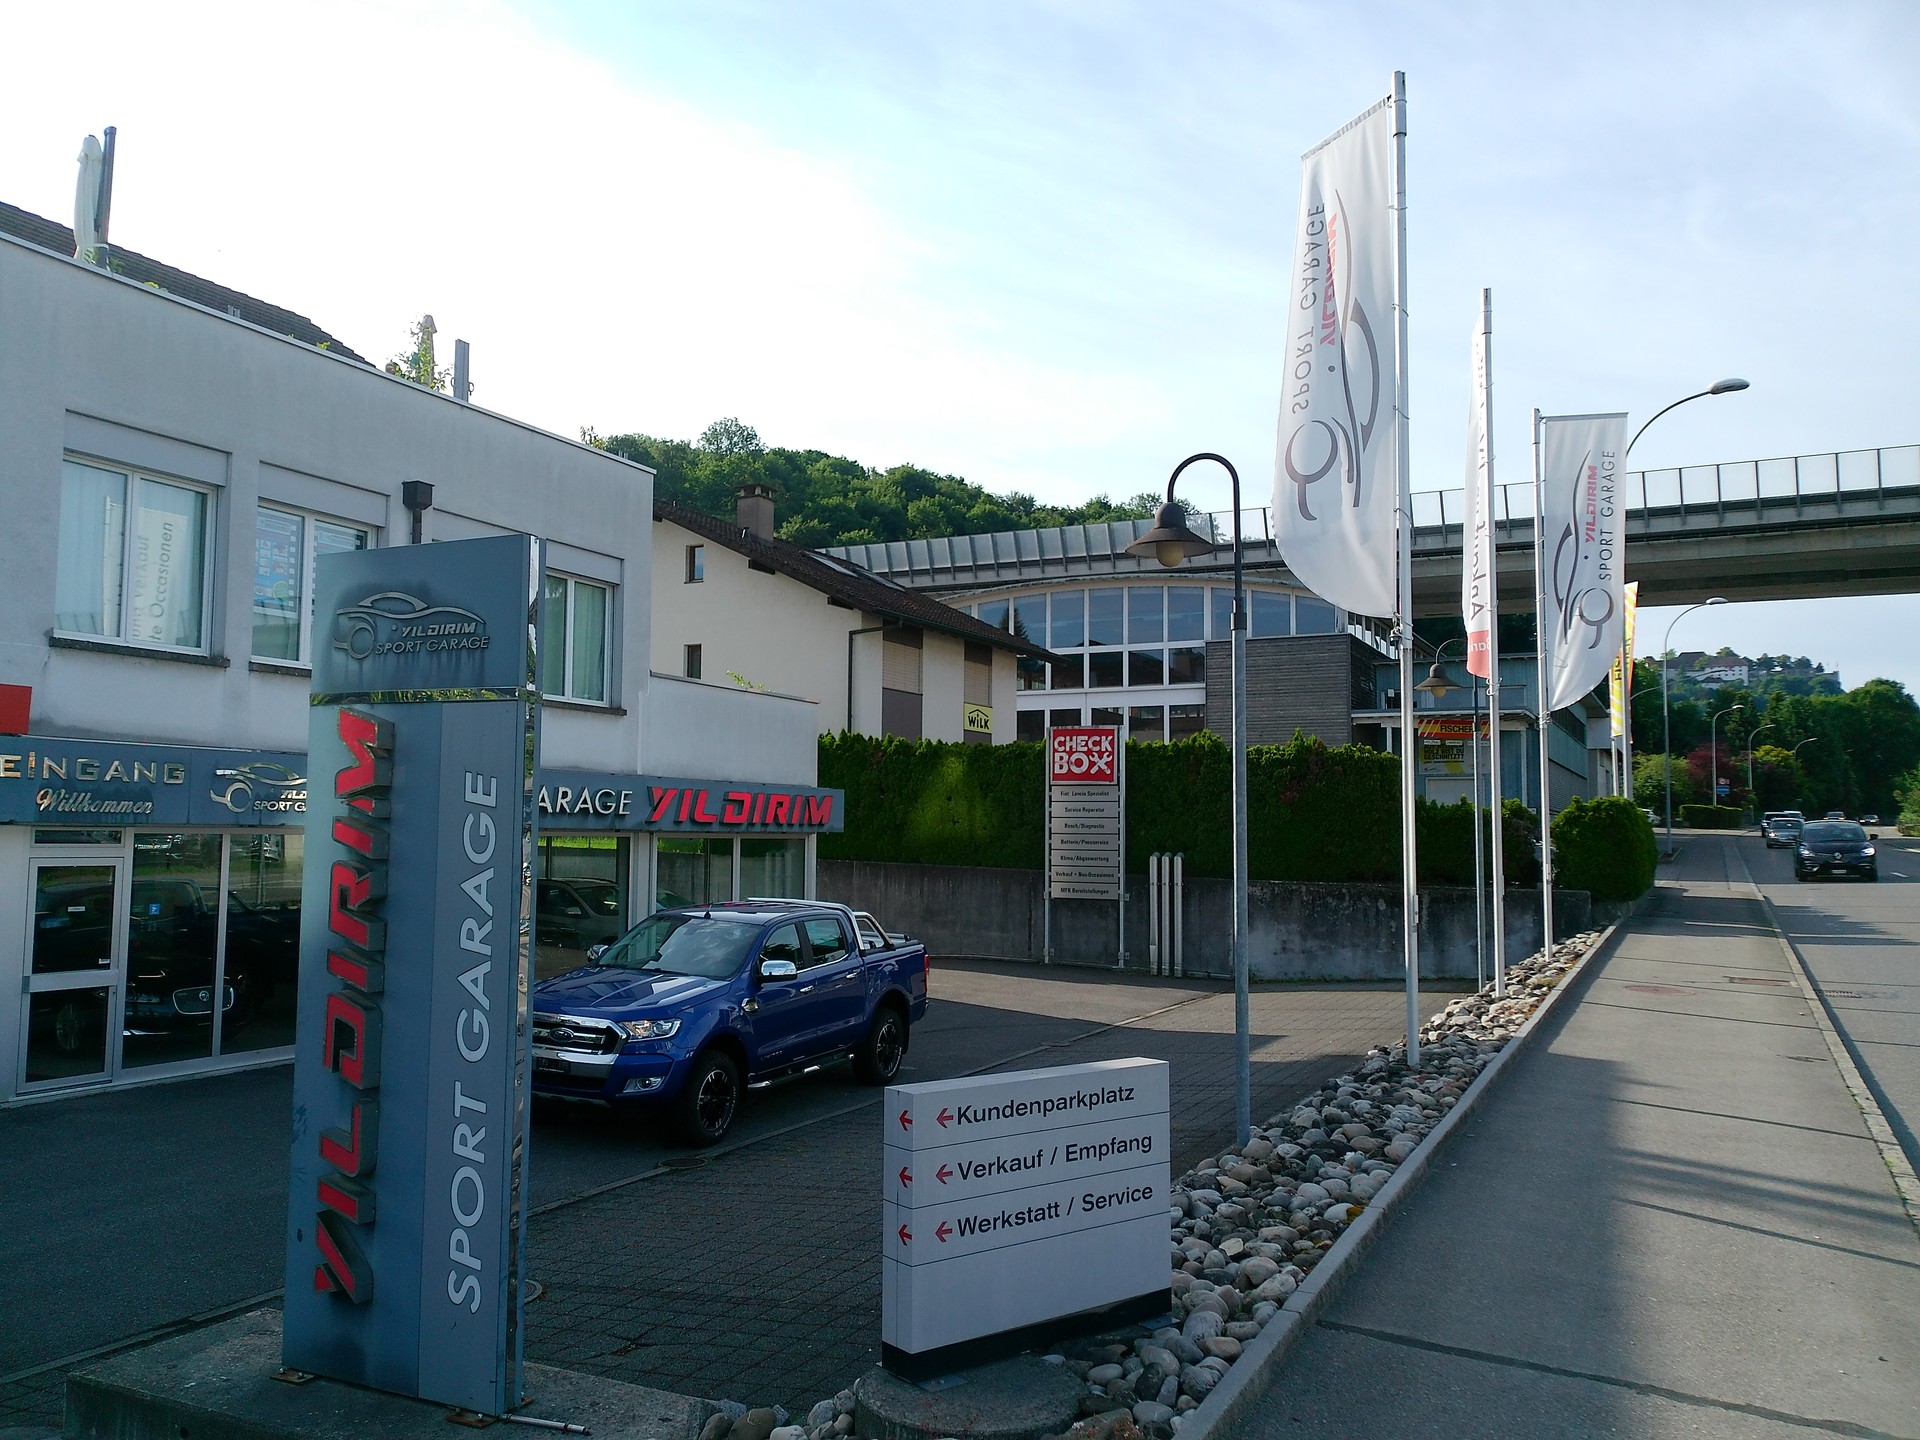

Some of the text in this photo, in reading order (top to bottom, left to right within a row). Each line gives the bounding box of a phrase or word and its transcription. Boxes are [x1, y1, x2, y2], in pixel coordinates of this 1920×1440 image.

[1585, 465, 1598, 544] YILDIRIM
[1599, 450, 1616, 582] SPORT GARAGE
[149, 522, 173, 618] Occasionen
[375, 636, 491, 655] SPORT GARAGE
[402, 622, 477, 637] YILDIRIM
[1053, 735, 1113, 752] CHECK
[1053, 751, 1113, 775] BOX
[36, 788, 153, 814] Willkommen
[253, 800, 293, 811] SPORT
[648, 786, 834, 825] YILDIRIM
[1082, 806, 1105, 814] Reparatur
[1087, 790, 1110, 798] Spezialist
[310, 706, 388, 1305] YILDIRIM
[448, 769, 498, 1314] SPORT GARAGE
[957, 1086, 1135, 1125] Kundenparkplatz
[957, 1135, 1152, 1181] Verkauf / Empfang
[957, 1186, 1154, 1237] Werkstatt / Service
